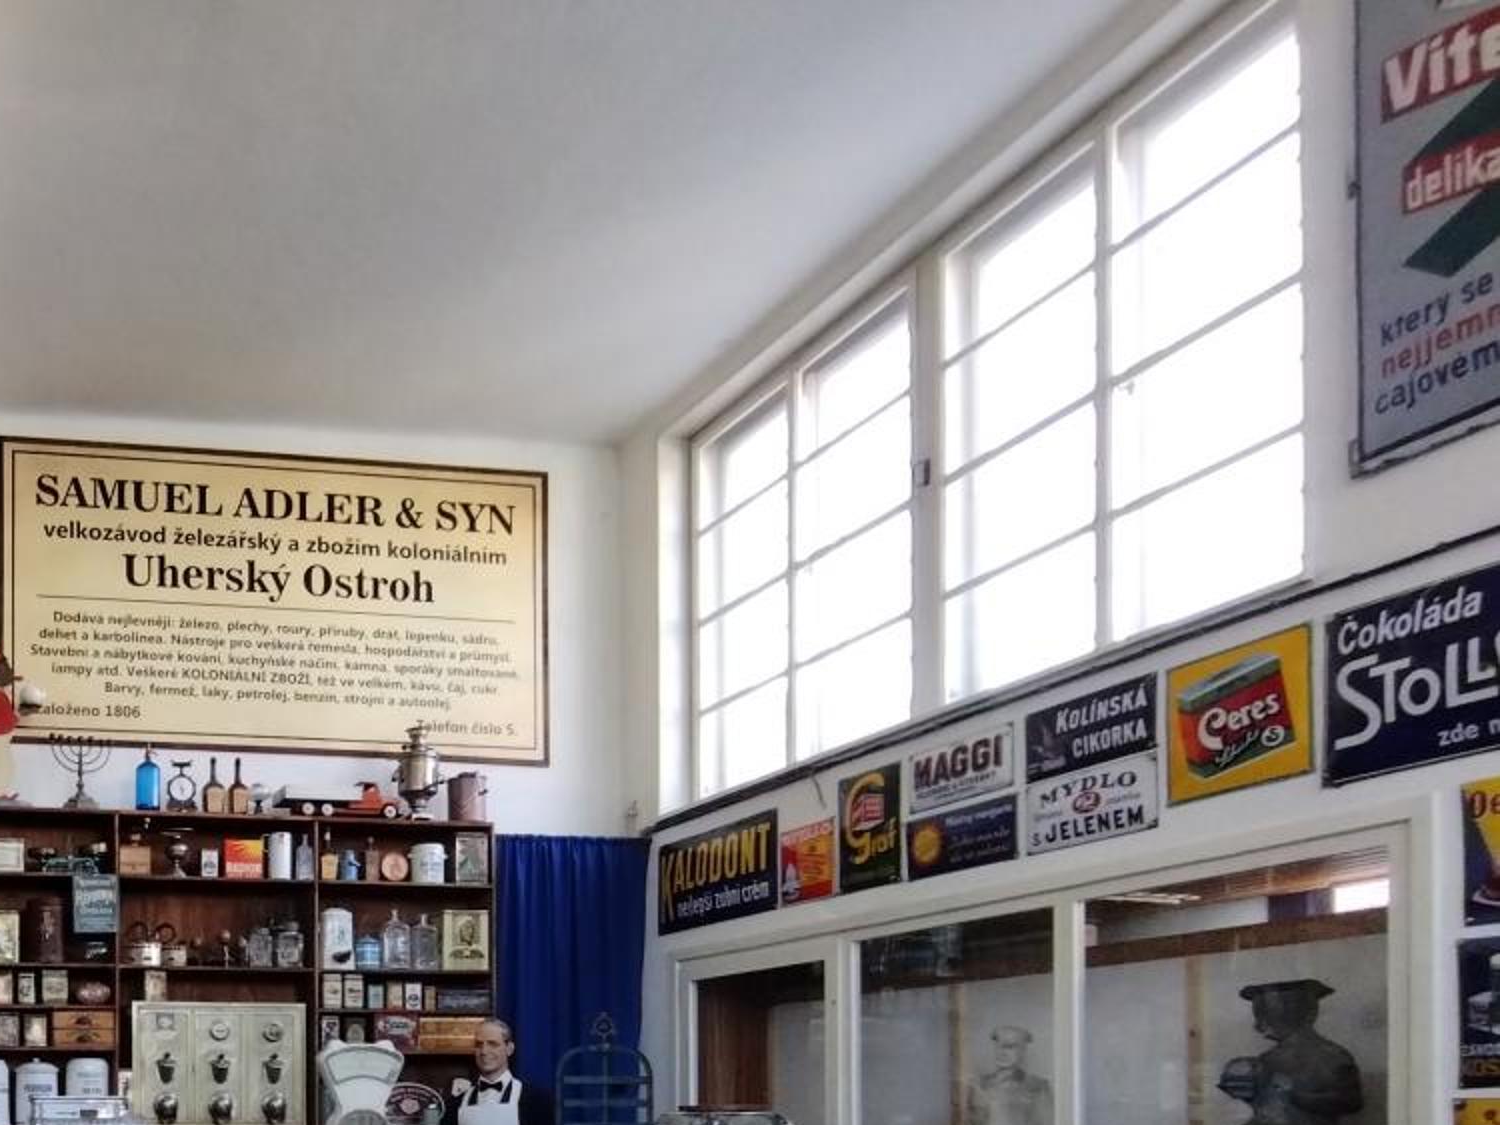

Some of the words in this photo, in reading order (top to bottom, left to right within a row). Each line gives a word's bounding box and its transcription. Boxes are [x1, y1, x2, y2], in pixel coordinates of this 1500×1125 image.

[1461, 272, 1494, 305] se
[36, 473, 223, 516] SAMUEL
[233, 486, 385, 527] ADLER
[395, 497, 423, 529] &
[435, 500, 516, 535] SYN
[44, 520, 166, 544] velkozávod
[173, 528, 281, 555] železářský
[288, 538, 299, 552] a
[122, 553, 291, 602] Uherský
[303, 563, 434, 602] Ostroh
[1337, 586, 1484, 656] Čokoláda
[105, 704, 142, 719] 1806
[1055, 683, 1149, 735] KOLÍNSKÁ
[1334, 630, 1500, 751] STOLL
[1072, 717, 1148, 758] CIKORKA
[1197, 692, 1281, 751] Ceres
[1438, 722, 1479, 748] zde
[914, 735, 1003, 788] MAGGI
[1045, 804, 1145, 843] JELENEM
[660, 822, 772, 924] KALODONT
